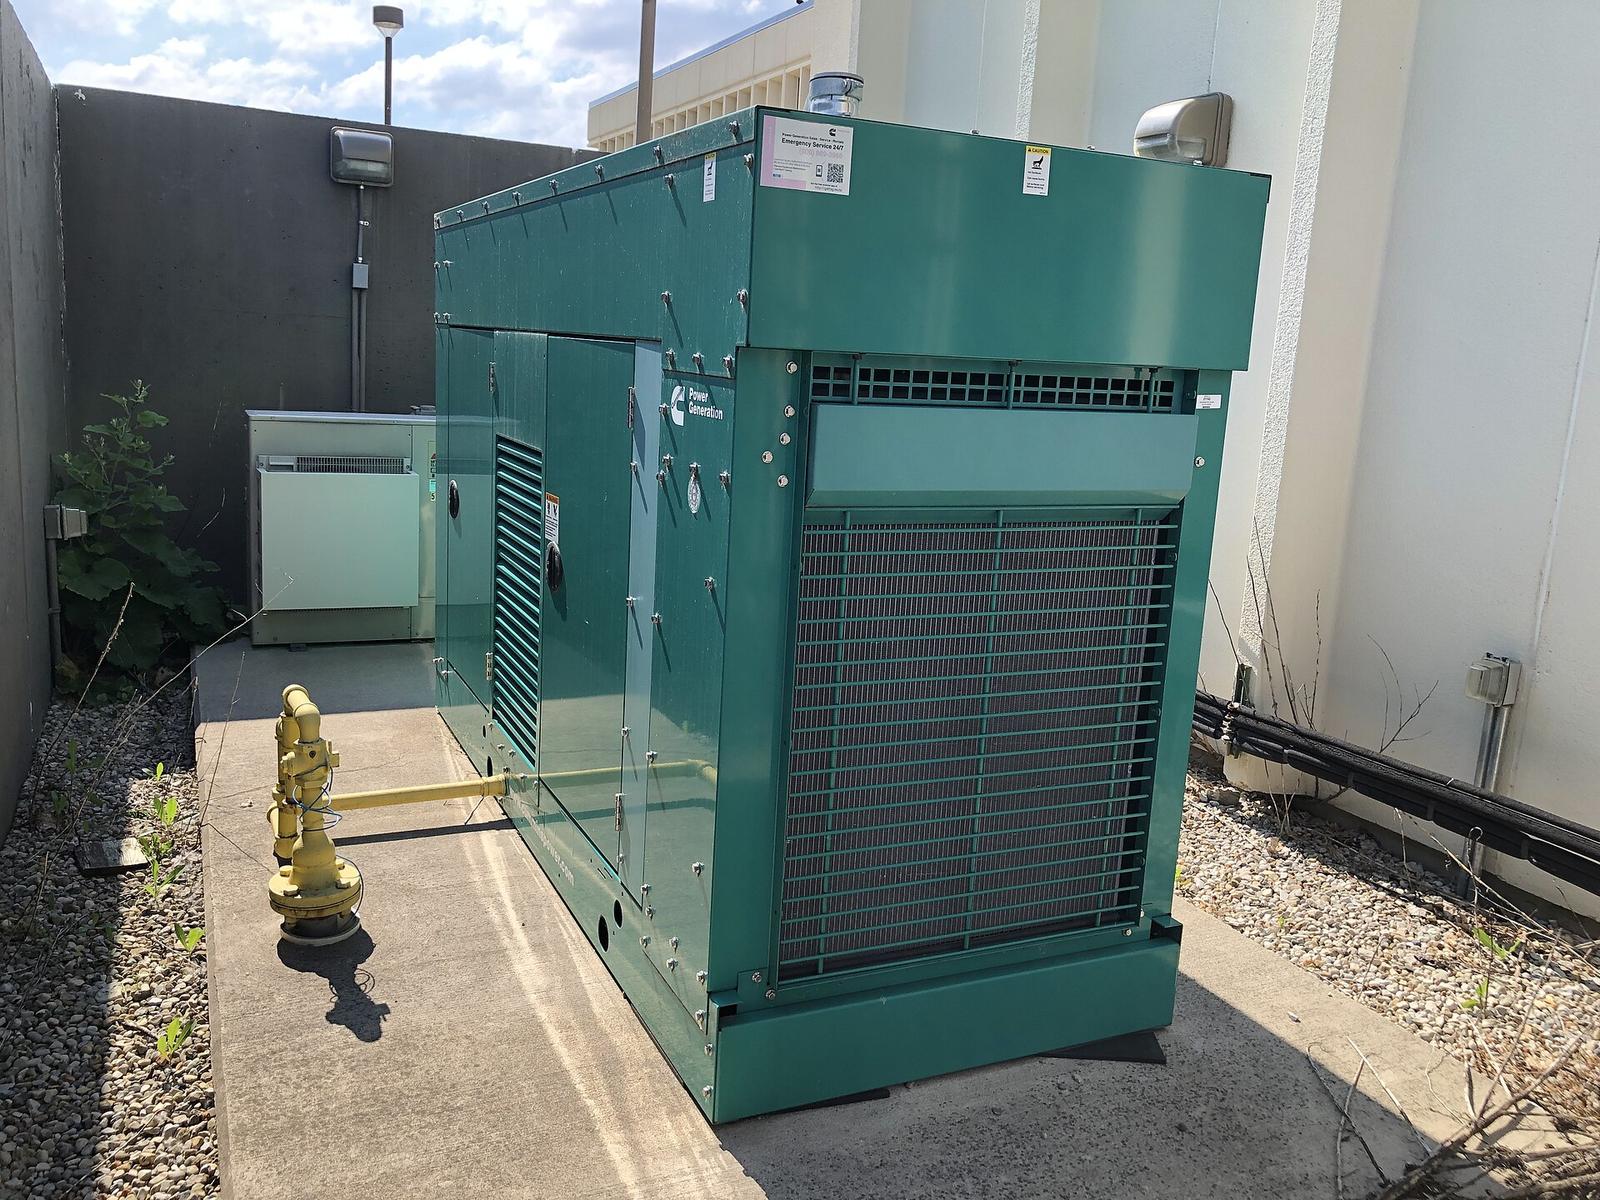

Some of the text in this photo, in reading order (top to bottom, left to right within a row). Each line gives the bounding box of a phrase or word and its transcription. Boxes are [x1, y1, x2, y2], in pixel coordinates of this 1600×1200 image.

[781, 138, 812, 147] Emergency
[689, 387, 709, 402] Power
[688, 401, 723, 420] Generation
